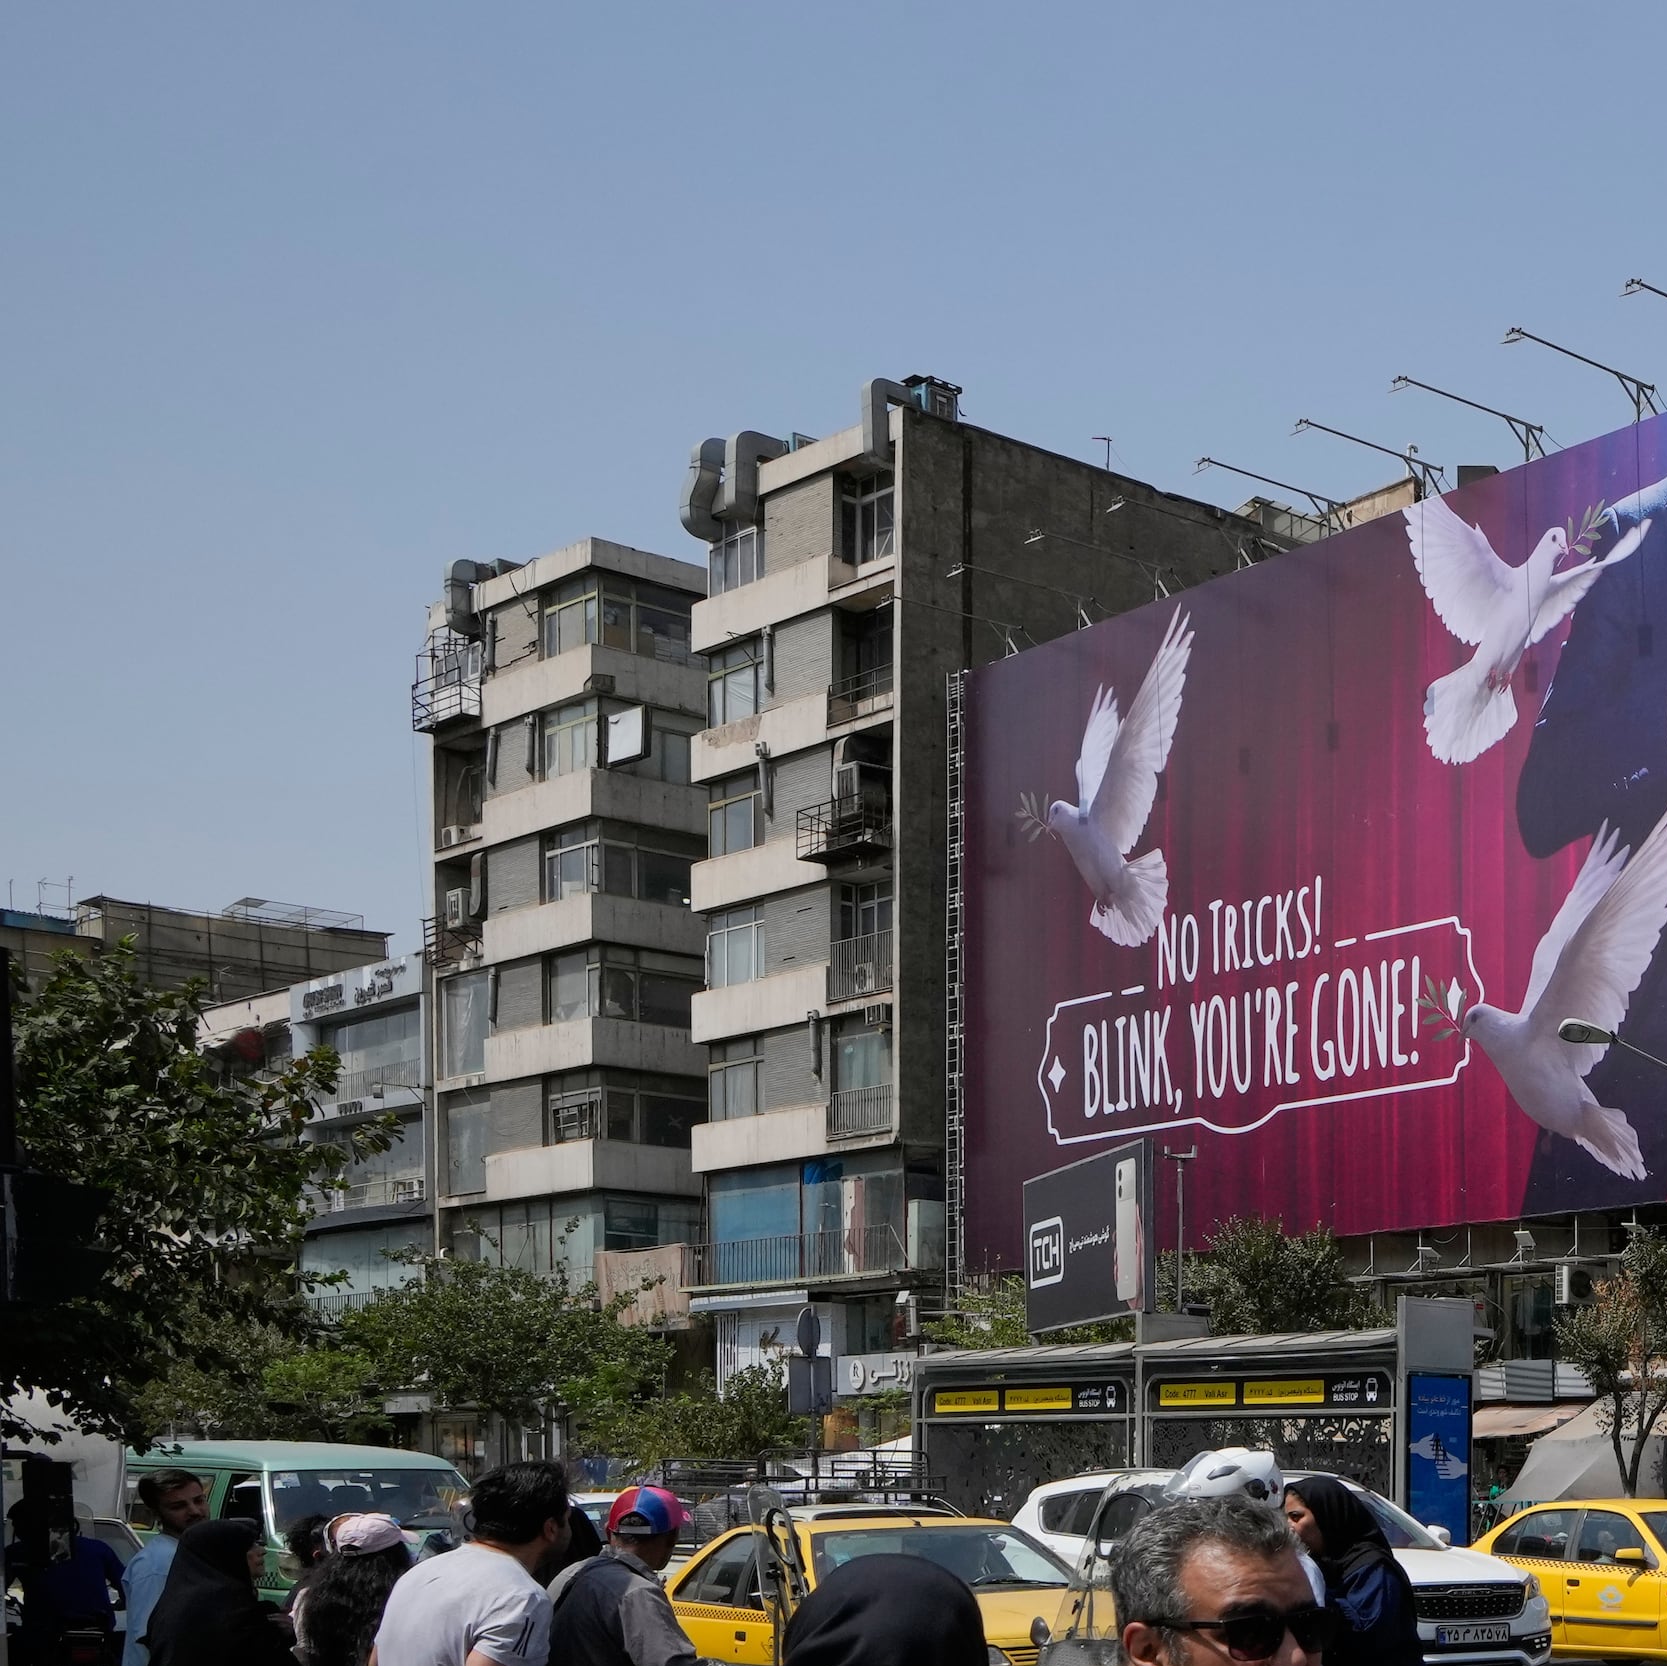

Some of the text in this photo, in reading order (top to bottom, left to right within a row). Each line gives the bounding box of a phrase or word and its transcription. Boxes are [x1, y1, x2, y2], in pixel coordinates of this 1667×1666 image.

[1157, 876, 1323, 990] NO TRICKS!
[1082, 955, 1421, 1120] BLINK, YOU'RE GONE!
[1033, 1233, 1060, 1271] TCH
[1079, 1399, 1101, 1408] BUS STOP
[1183, 1389, 1197, 1398] 4777
[1333, 1392, 1359, 1402] BUS STOP
